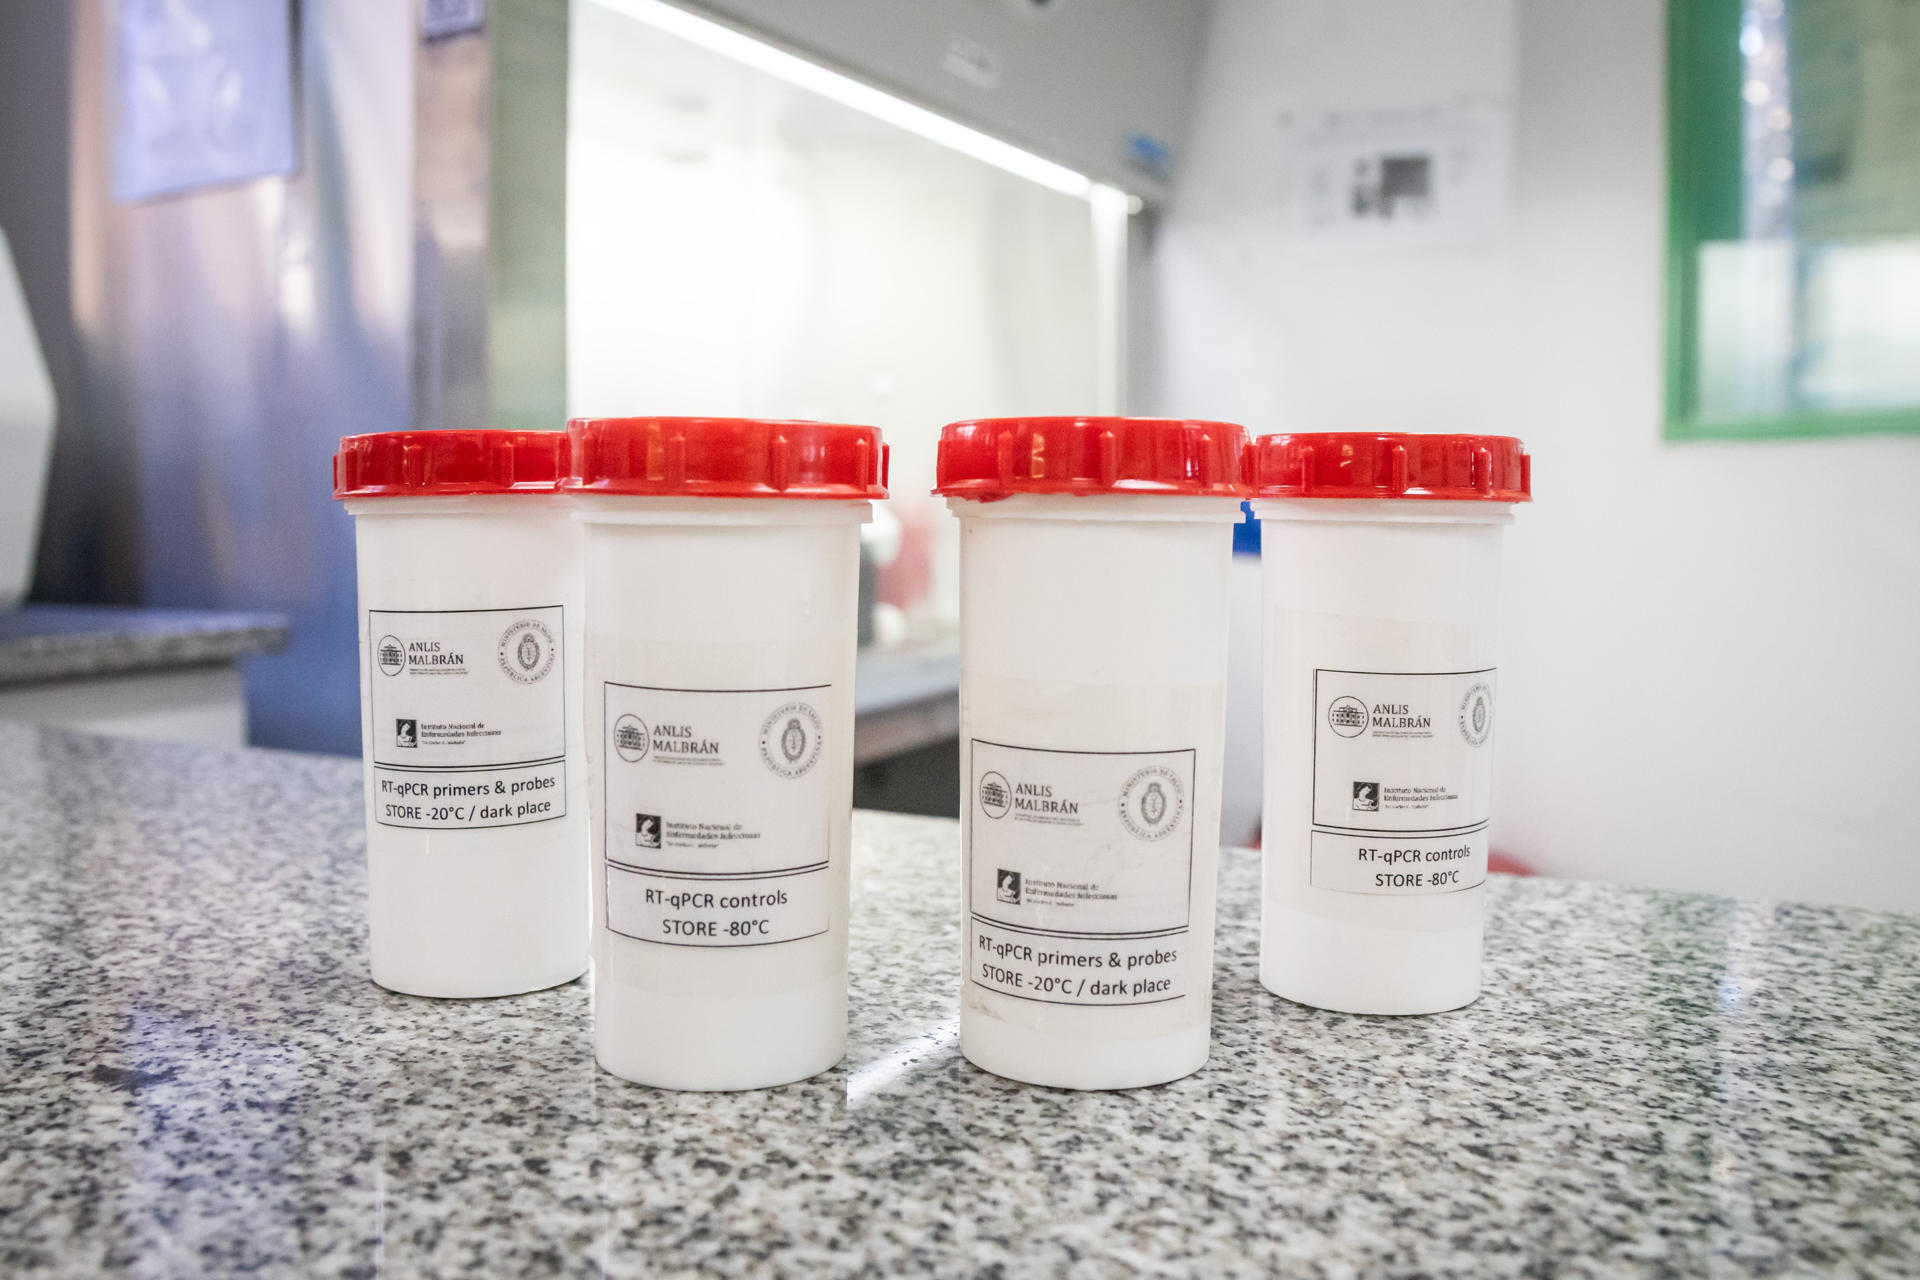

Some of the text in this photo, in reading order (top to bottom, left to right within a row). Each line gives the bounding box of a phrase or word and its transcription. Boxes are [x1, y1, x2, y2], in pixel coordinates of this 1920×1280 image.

[408, 641, 441, 652] ANLIS
[408, 652, 464, 665] MALBRÁN
[1373, 704, 1409, 715] ANLIS
[1372, 715, 1431, 728] MALBRÁN
[653, 725, 692, 738] ANLIS
[652, 739, 719, 754] MALBRÁN
[381, 776, 556, 799] RT-qPCR primers & probes
[1015, 783, 1053, 797] ANLIS
[385, 801, 551, 822] STORE -20°C / dark place
[1014, 799, 1079, 814] MALBRÁN
[1358, 844, 1471, 866] RT-qPCR controls
[1375, 870, 1460, 887] STORE -80°C
[645, 889, 788, 910] RT-qPCR controls
[663, 919, 770, 936] STORE -80°C
[978, 935, 1177, 970] RT-qPCR primers & probes
[982, 963, 1172, 997] STORE -20°C / dark place
